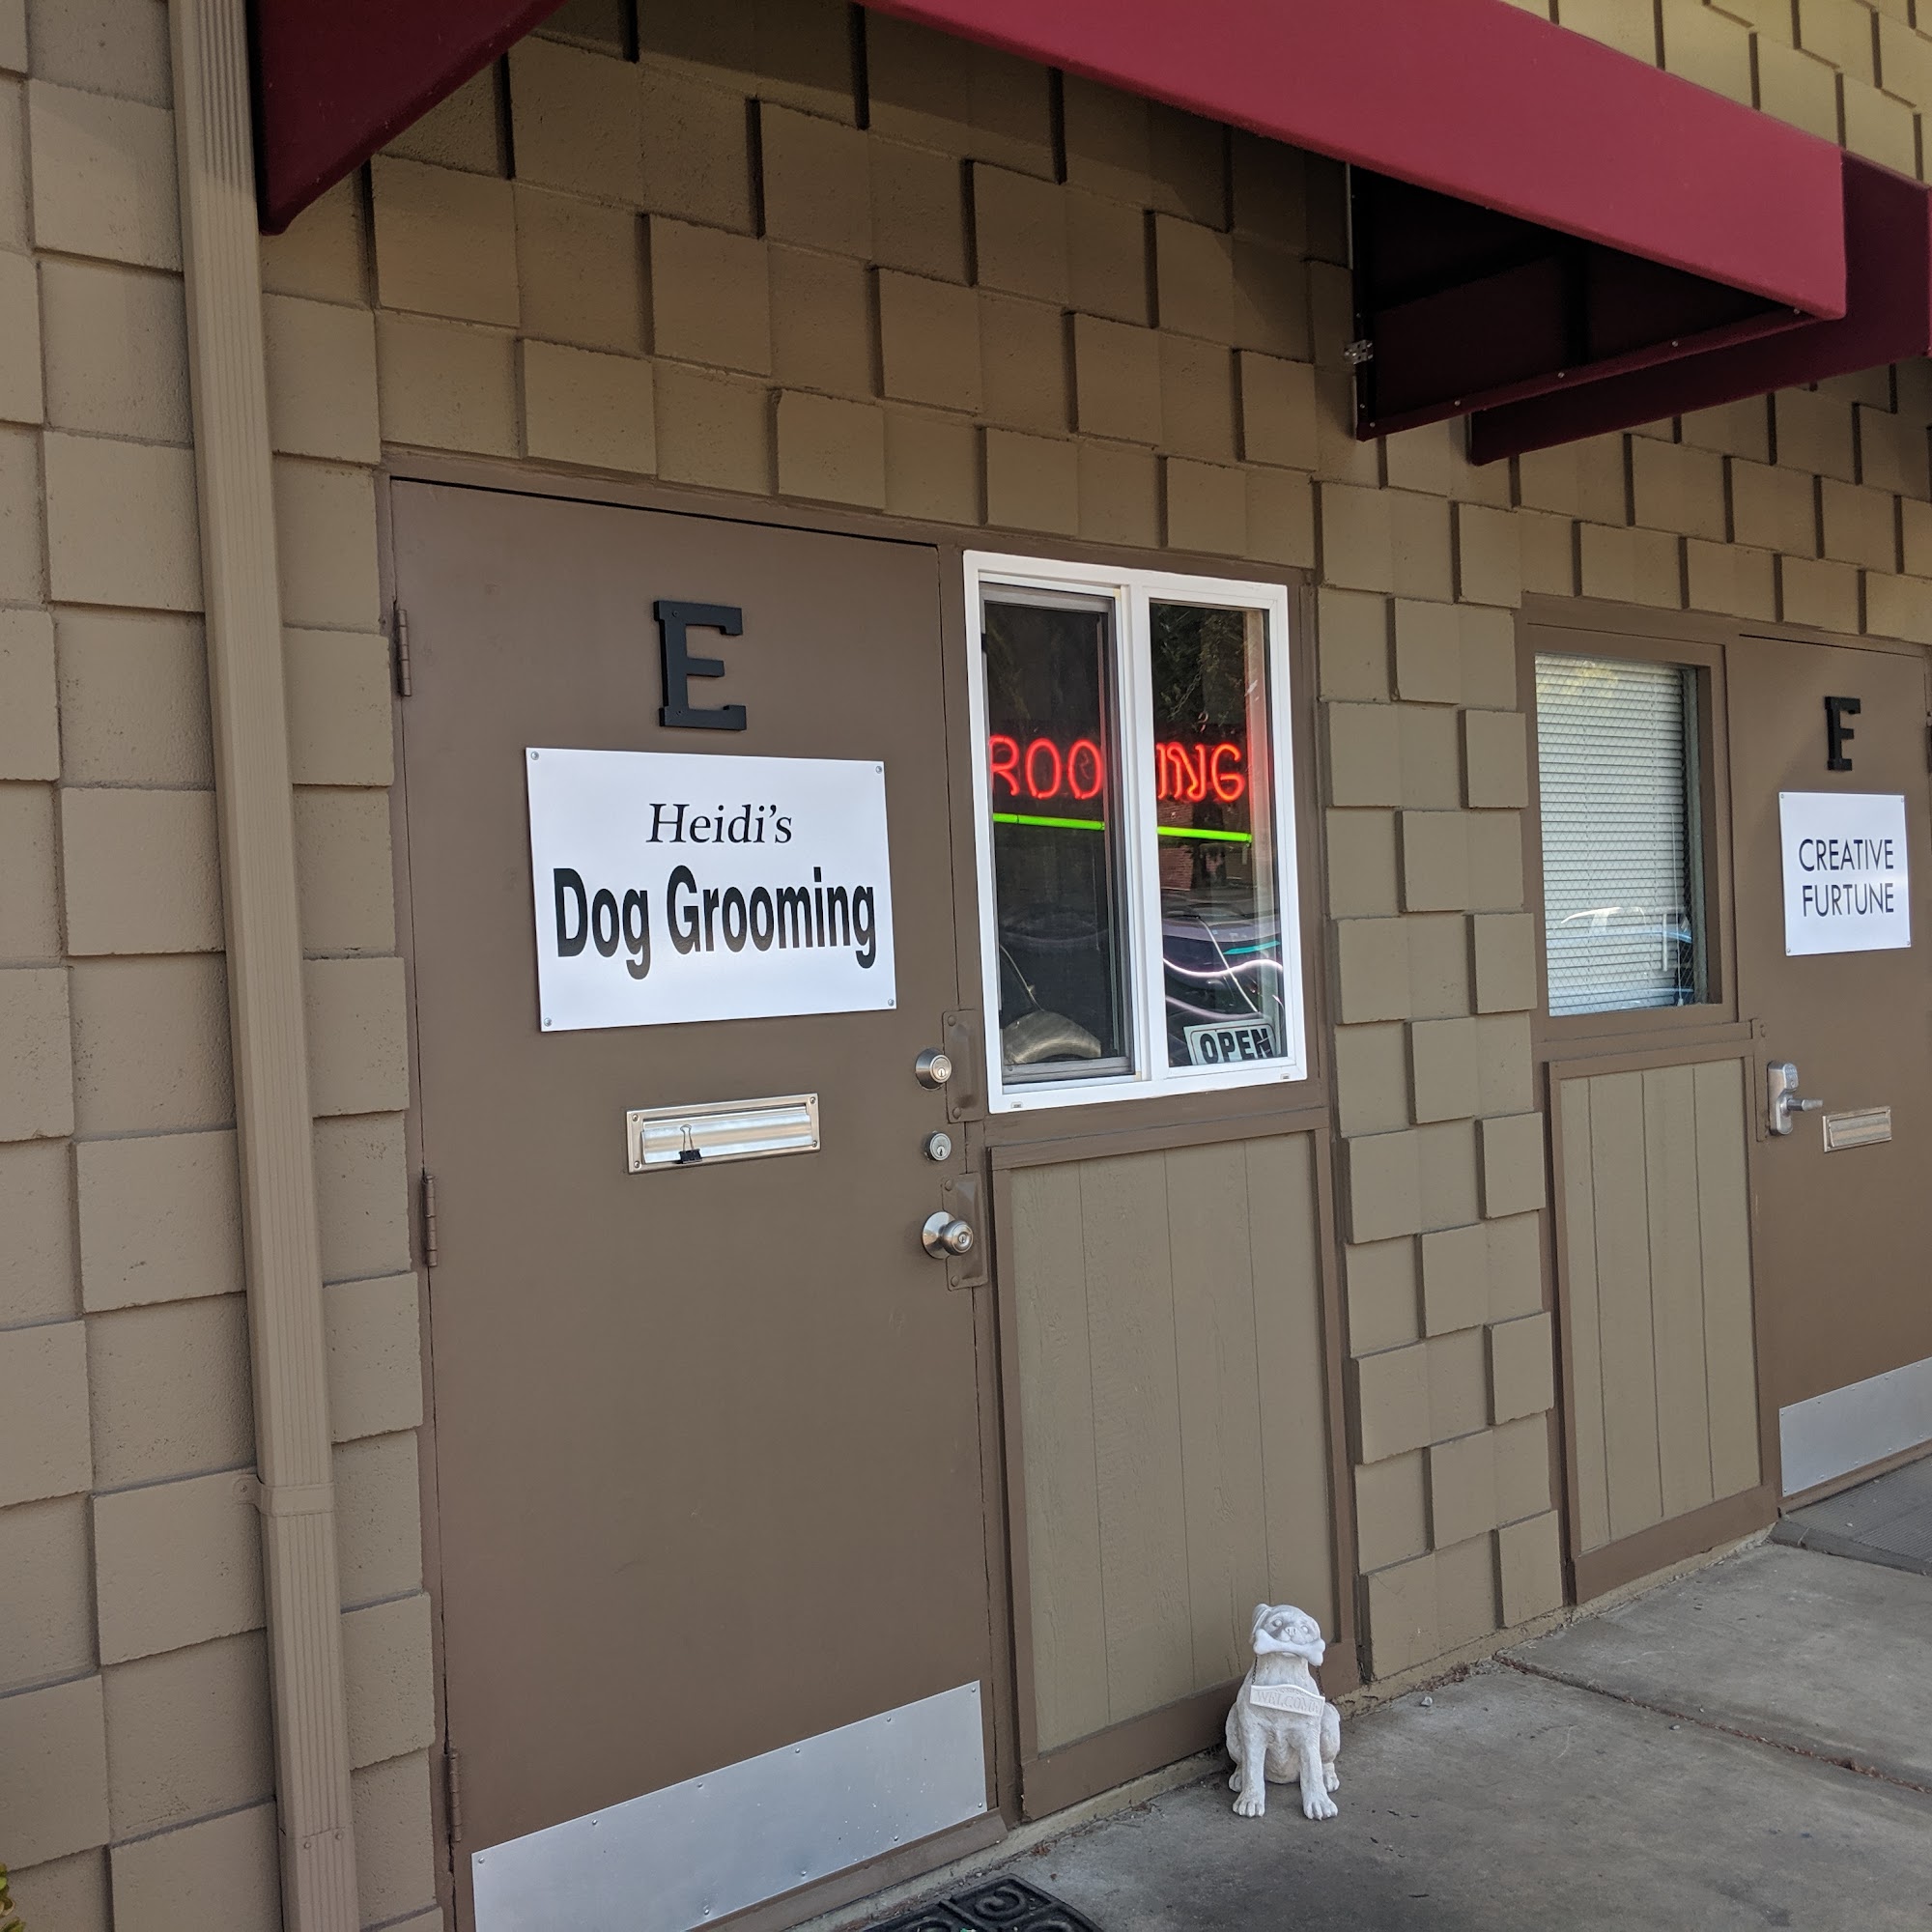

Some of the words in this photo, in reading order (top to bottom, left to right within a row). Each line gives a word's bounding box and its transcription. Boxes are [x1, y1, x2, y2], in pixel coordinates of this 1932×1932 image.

[653, 600, 747, 730] E
[1824, 696, 1861, 771] F
[645, 803, 793, 844] Heidi's
[1799, 838, 1894, 871] CREATIVE
[1803, 883, 1894, 917] FURTUNE
[553, 867, 651, 980] Dog
[667, 865, 876, 969] Grooming
[1200, 1028, 1275, 1065] OPEN
